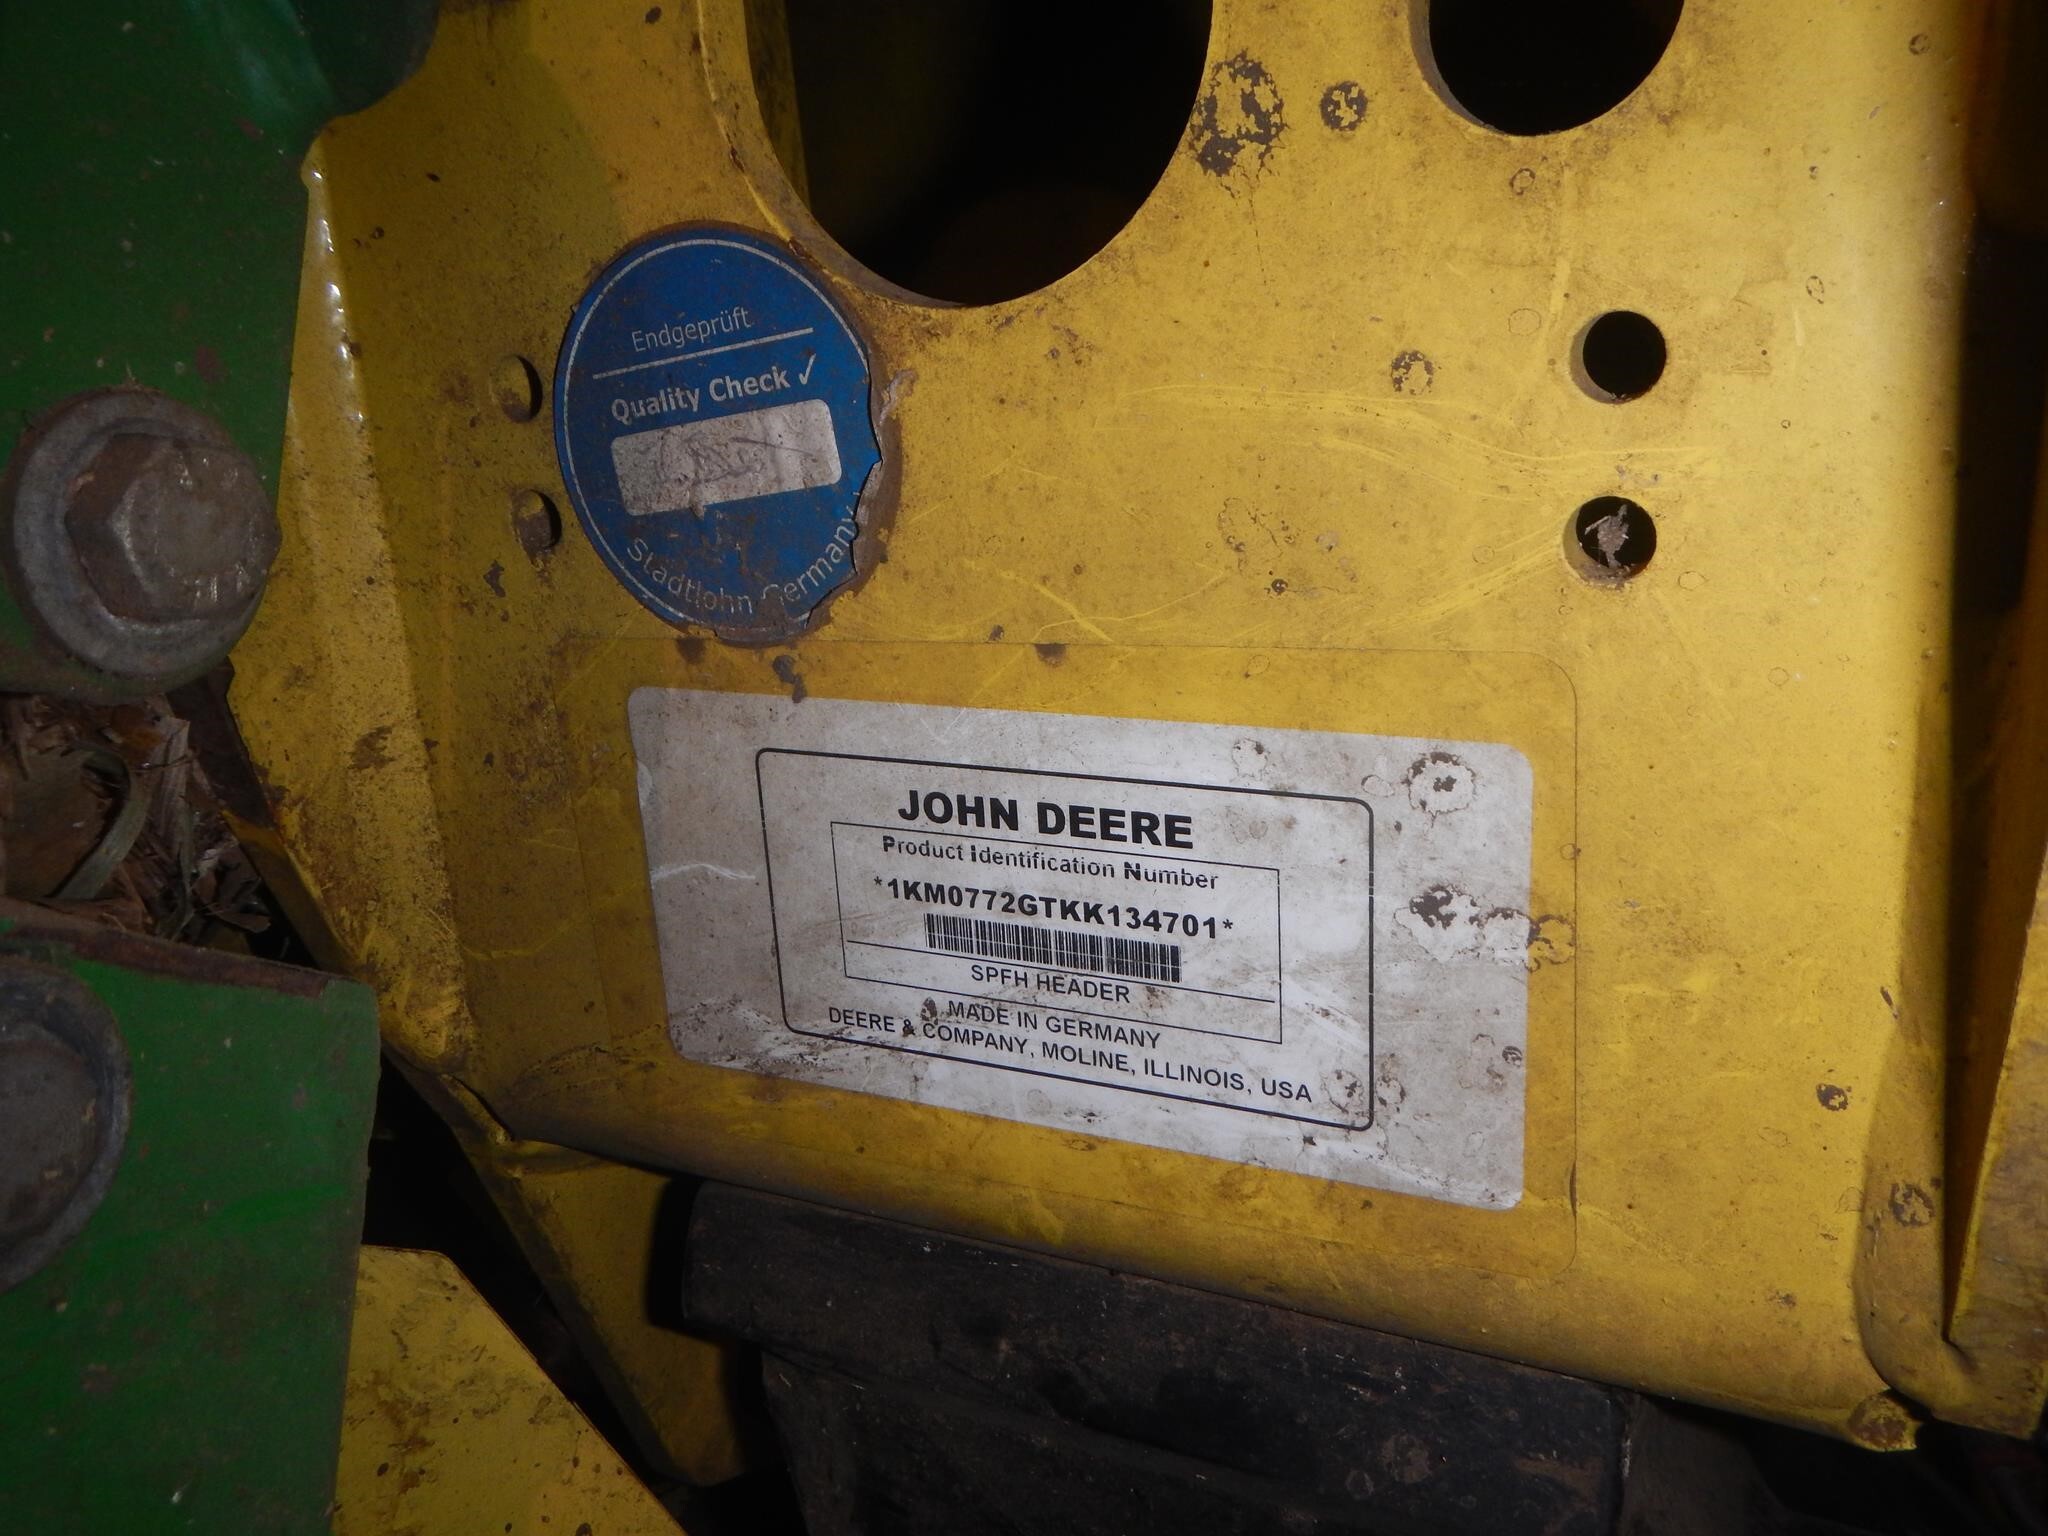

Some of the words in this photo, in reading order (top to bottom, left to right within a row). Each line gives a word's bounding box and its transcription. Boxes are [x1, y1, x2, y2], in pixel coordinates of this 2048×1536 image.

[632, 306, 752, 353] Endgeprüft
[611, 386, 701, 426] Quality
[709, 366, 791, 402] Check
[626, 537, 754, 615] Stadtlohn
[898, 789, 1019, 831] JOHN
[1038, 802, 1194, 850] DEERE
[883, 835, 965, 862] Product
[970, 845, 1116, 880] Identification
[1123, 861, 1220, 889] Number
[971, 964, 1029, 990] SPFH
[1036, 974, 1131, 1004] HEADER
[948, 1000, 1010, 1027] MADE
[1017, 1009, 1038, 1030] IN
[1045, 1015, 1162, 1049] GERMANY
[828, 1006, 895, 1034] DEERE
[902, 1018, 916, 1037] &
[922, 1020, 1035, 1059] COMPANY,
[1041, 1042, 1136, 1077] MOLINE,
[1143, 1057, 1253, 1095] ILLINOIS,
[1261, 1078, 1313, 1104] USA
